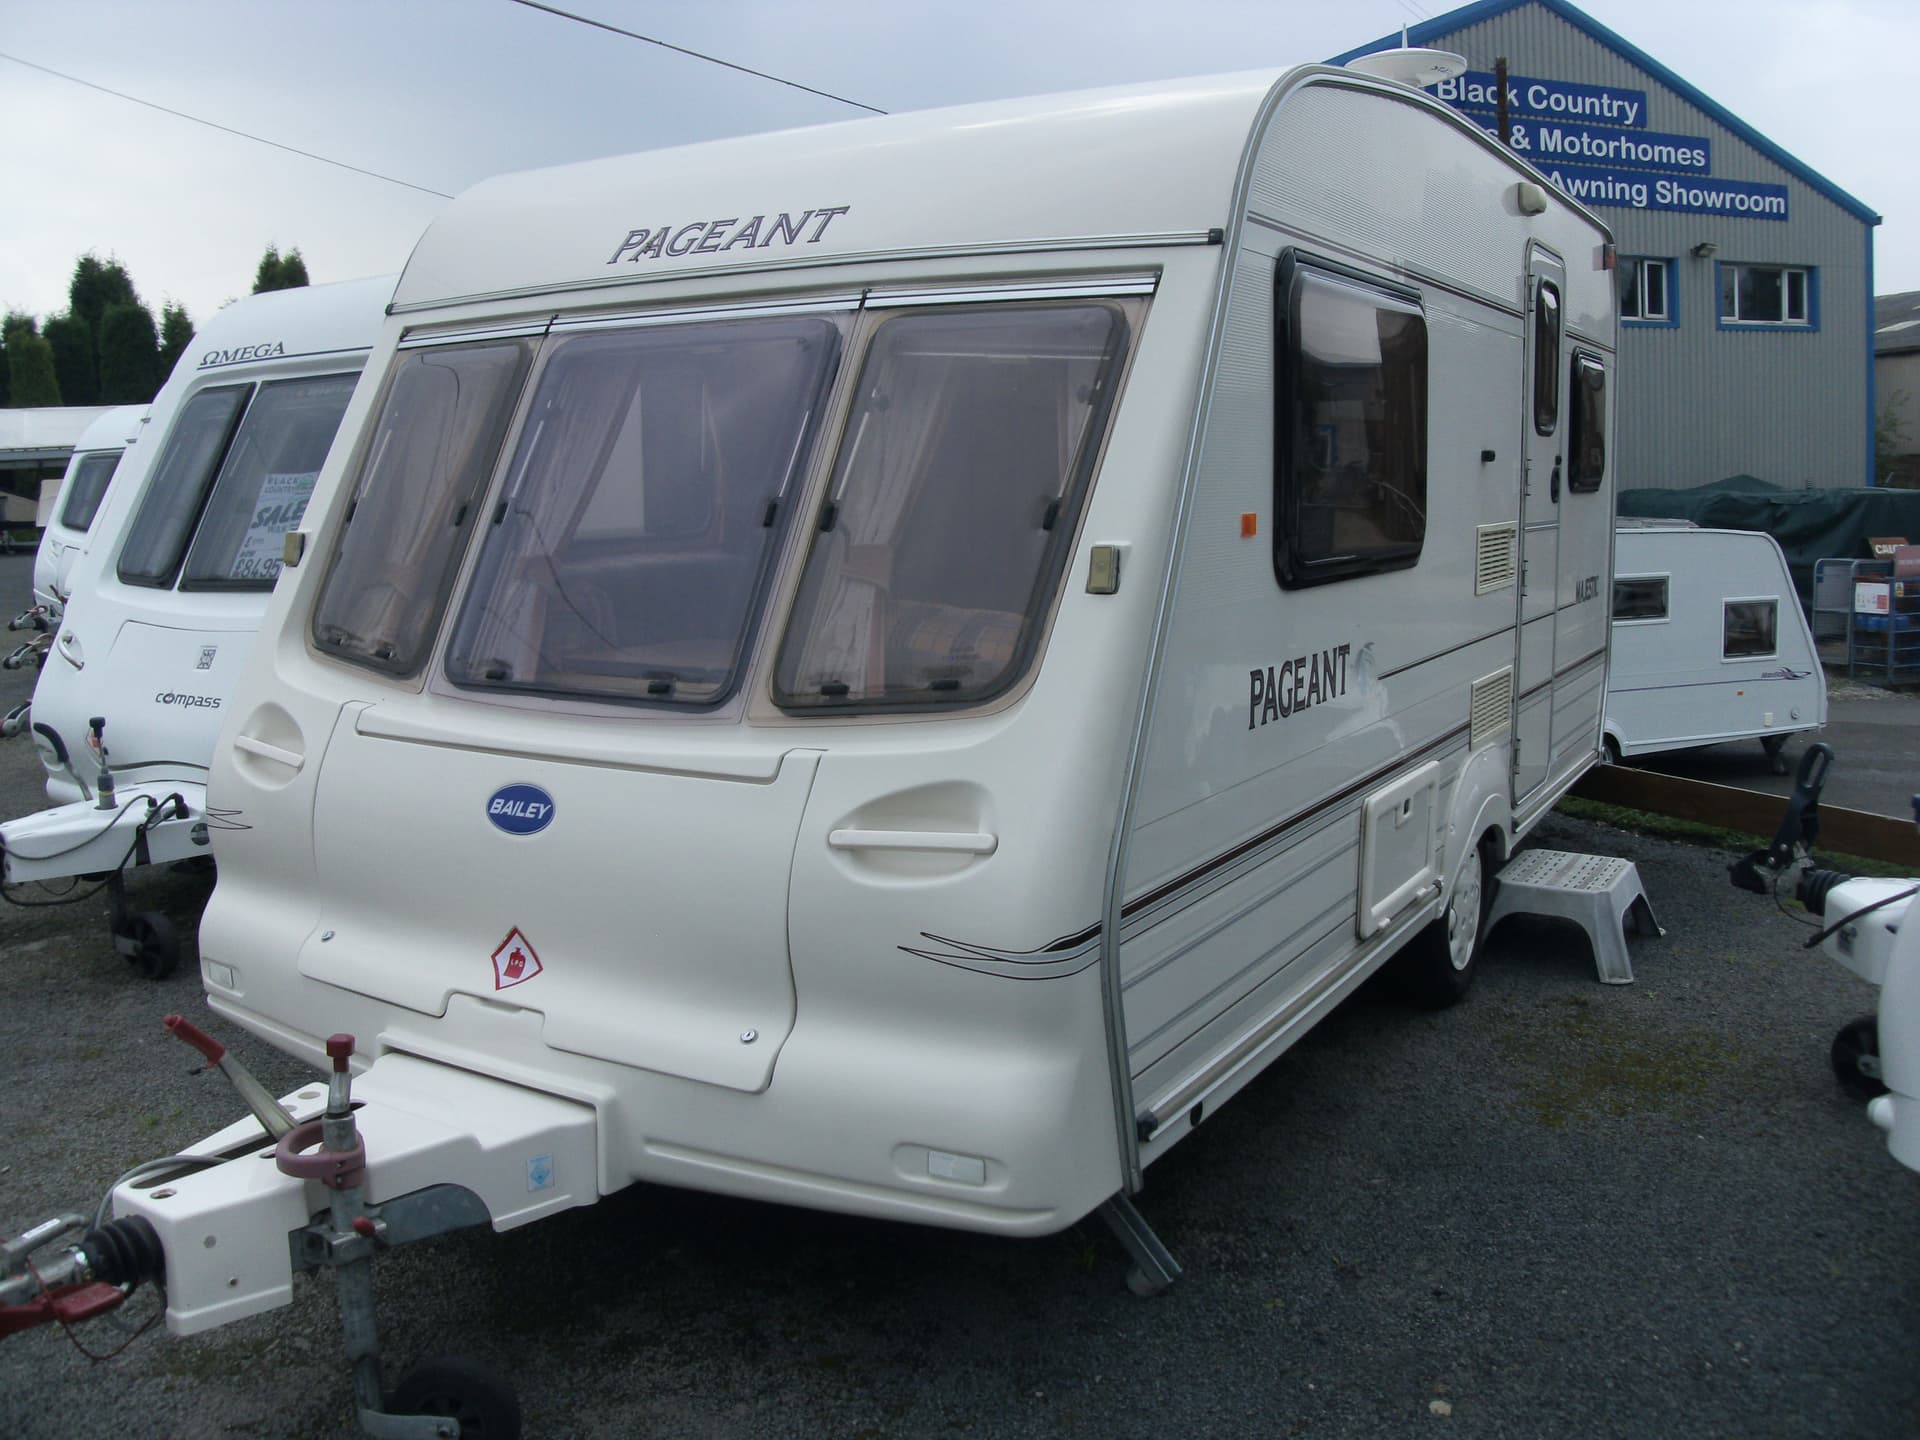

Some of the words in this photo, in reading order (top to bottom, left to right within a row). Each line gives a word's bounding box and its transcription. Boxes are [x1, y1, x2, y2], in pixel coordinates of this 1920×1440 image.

[1437, 76, 1519, 107] Black
[1527, 84, 1638, 125] Country
[1508, 124, 1531, 150] &
[1539, 126, 1706, 167] Motorhomes
[1550, 170, 1648, 207] Awning
[1655, 179, 1786, 214] Showroom
[606, 205, 850, 265] PAGEANT
[251, 500, 308, 529] SALE
[155, 691, 222, 709] compass
[1249, 642, 1350, 730] PAGEANT
[489, 798, 551, 820] BAILEY
